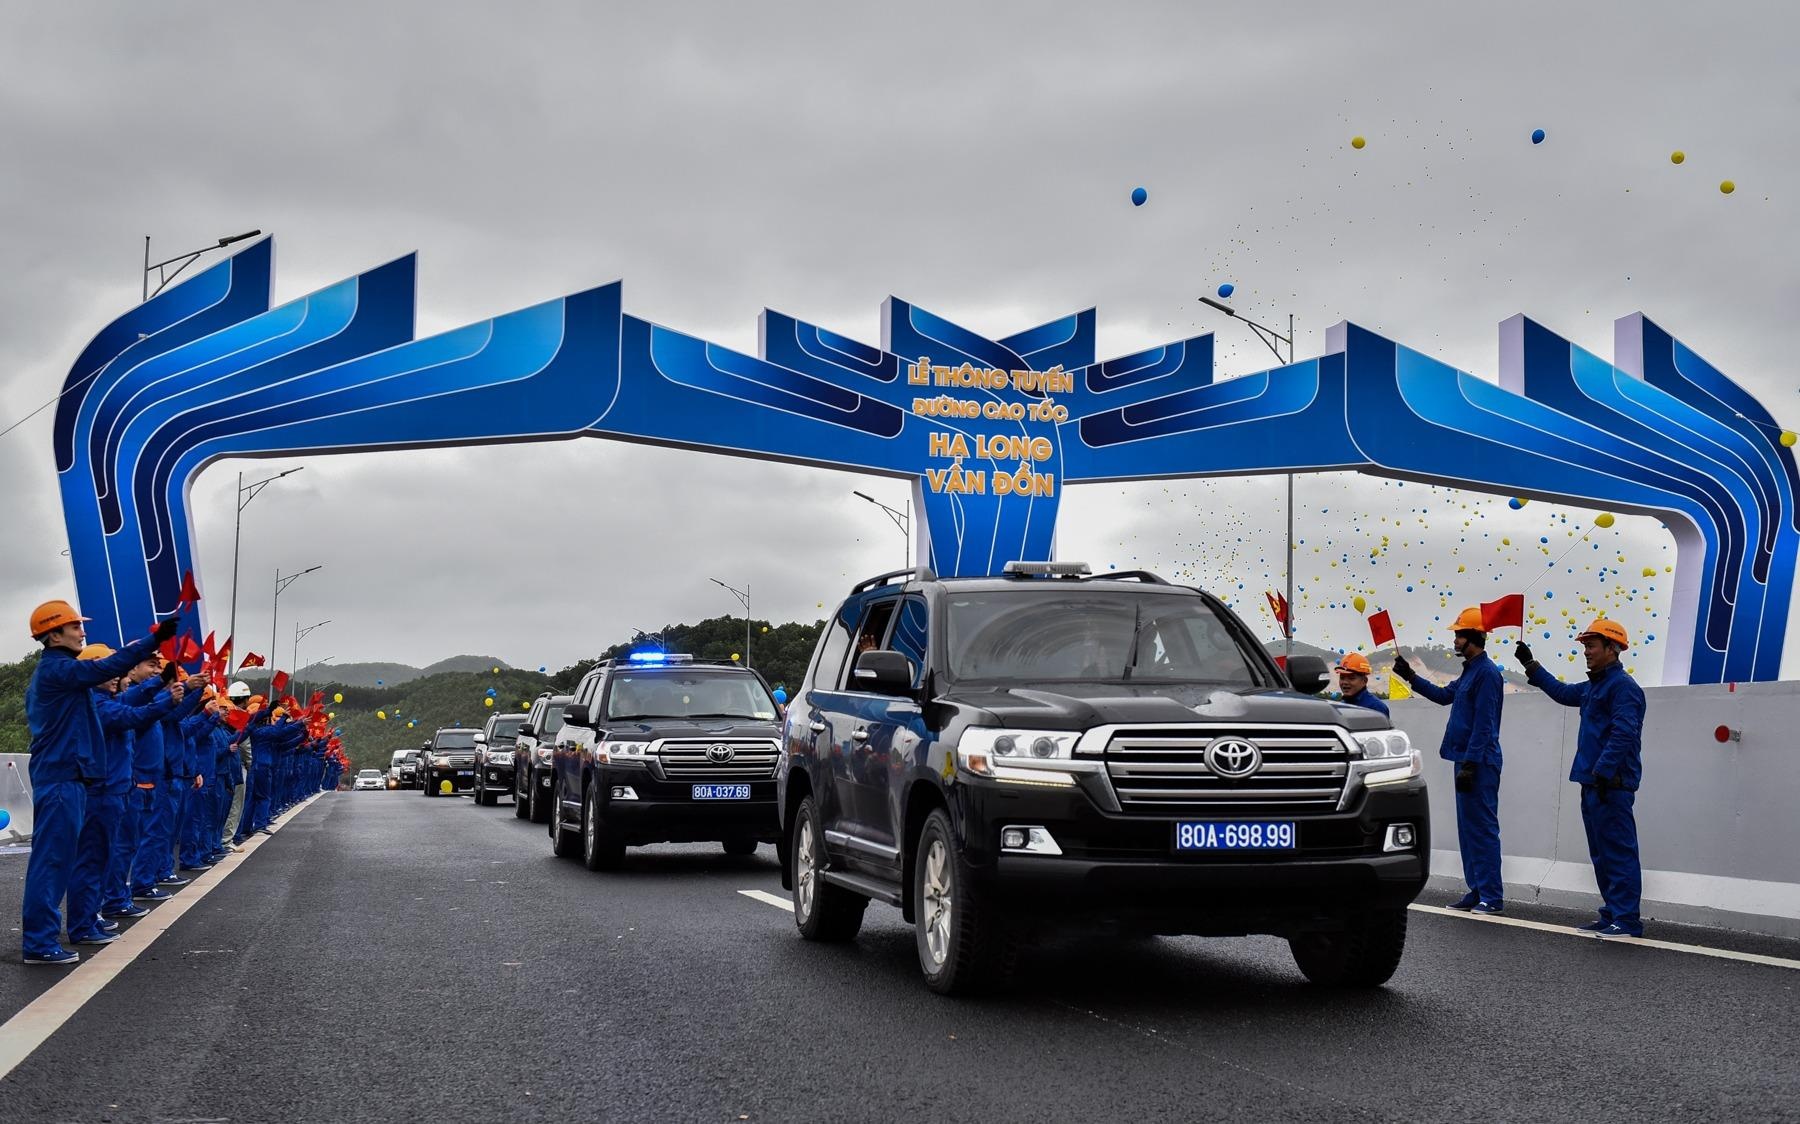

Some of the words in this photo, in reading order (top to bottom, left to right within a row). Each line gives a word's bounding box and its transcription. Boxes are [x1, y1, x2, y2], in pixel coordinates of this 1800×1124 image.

[908, 357, 930, 386] LỄ
[932, 362, 1008, 389] THÔNG
[1010, 364, 1074, 393] TUYẾN
[912, 394, 981, 418] ĐƯỜNG
[982, 402, 1025, 420] CAO
[1027, 398, 1069, 422] TỐC
[929, 432, 970, 465] HẠ
[976, 434, 1053, 461] LONG
[926, 464, 986, 495] VÂN
[992, 460, 1054, 497] ĐỒN
[694, 786, 749, 798] 80A-037.69
[1180, 824, 1291, 848] 80A-698.99
